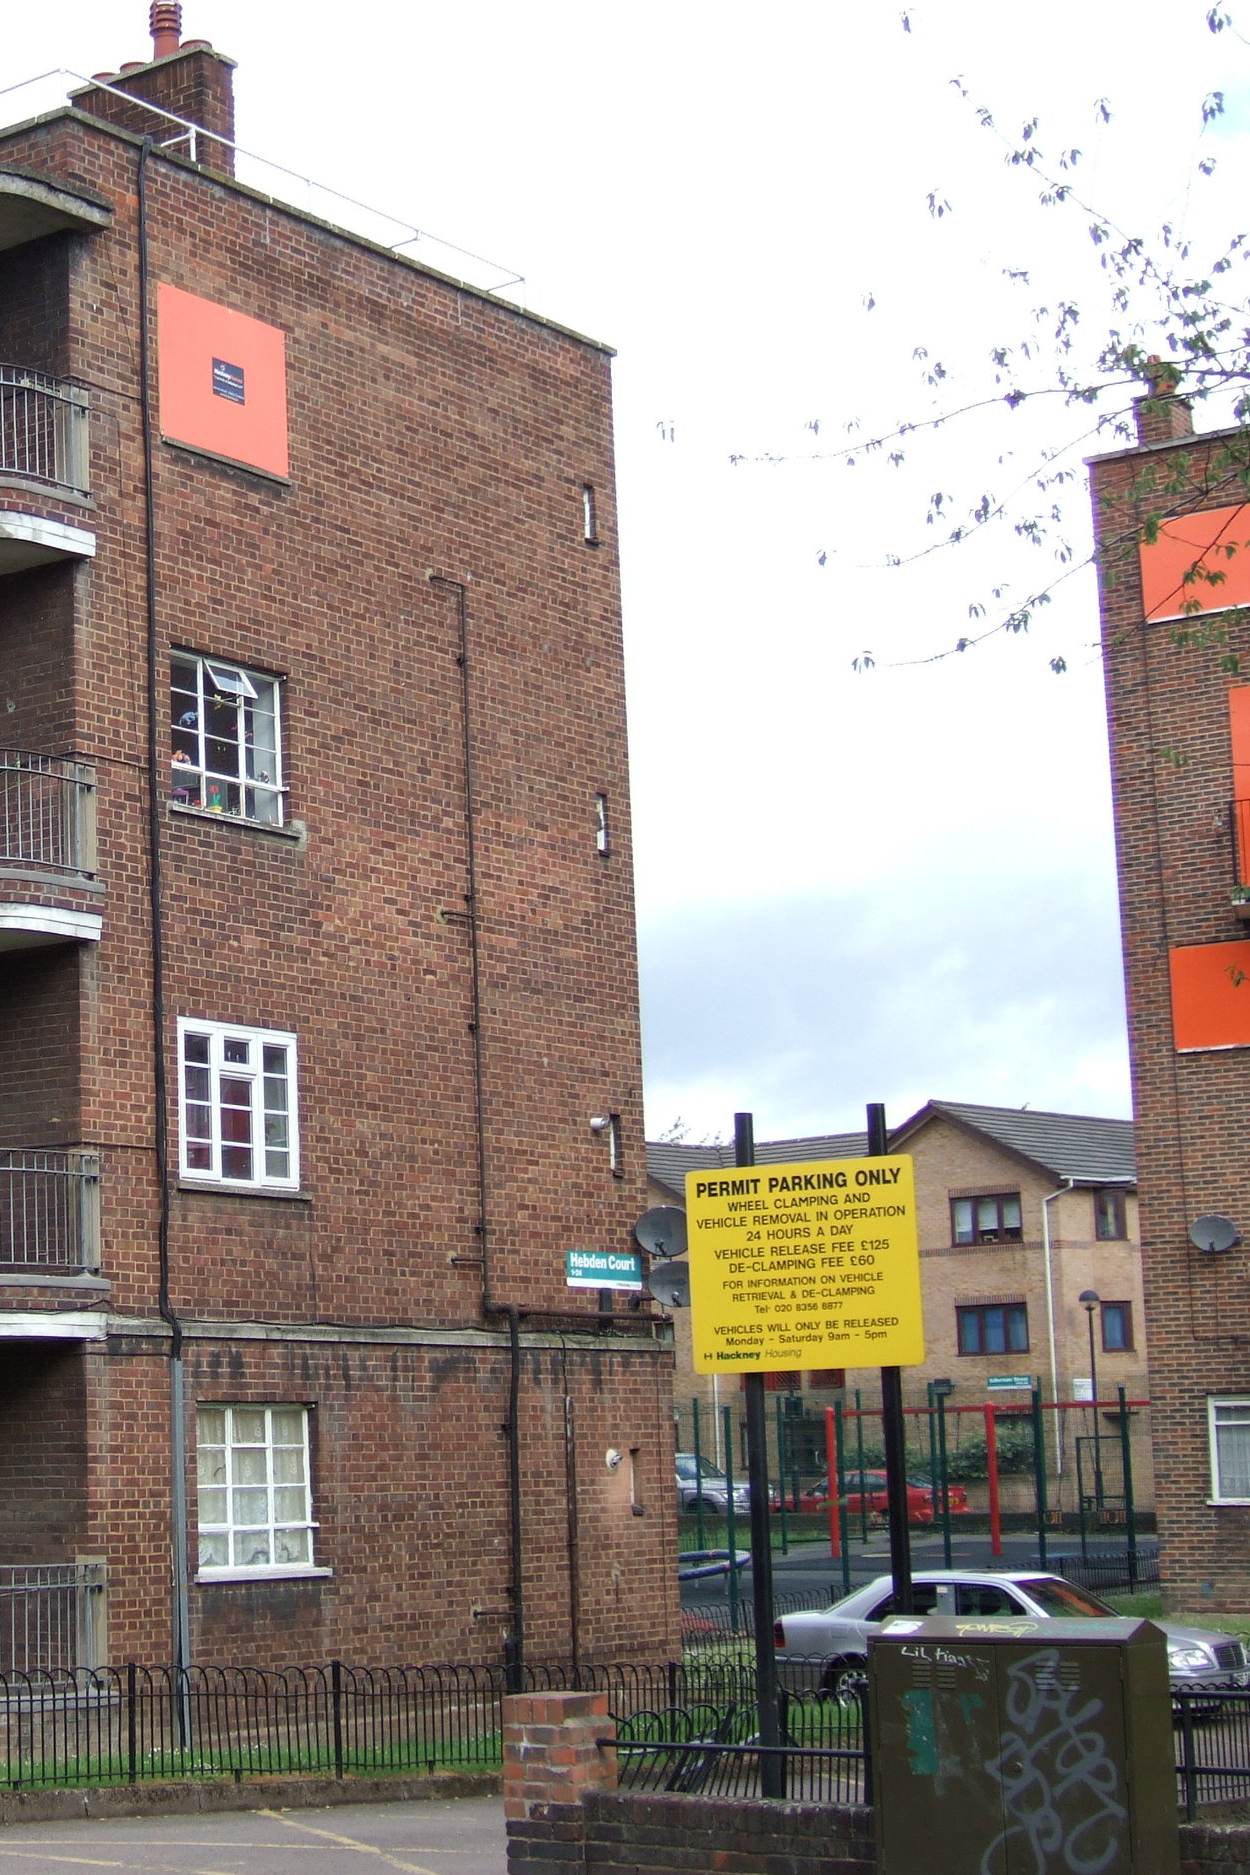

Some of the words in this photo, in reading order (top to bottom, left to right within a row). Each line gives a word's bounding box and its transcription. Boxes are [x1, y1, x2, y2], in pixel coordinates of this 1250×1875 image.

[696, 1178, 761, 1198] PERMIT
[768, 1172, 847, 1193] PARKING
[855, 1167, 901, 1187] ONLY
[727, 1200, 769, 1212] WHEEL
[774, 1194, 838, 1209] CLAMPING
[844, 1192, 871, 1204] AND
[696, 1216, 747, 1229] VEHICLE
[753, 1212, 812, 1226] REMOVAL
[816, 1211, 828, 1221] IN
[833, 1205, 906, 1220] OPERATION
[746, 1231, 761, 1241] 24
[767, 1227, 811, 1240] HOURS
[816, 1226, 825, 1236] A
[830, 1224, 854, 1236] DAY
[714, 1247, 765, 1260] VEHICLE
[770, 1243, 826, 1256] RELEASE
[831, 1241, 854, 1253] FEE
[861, 1239, 890, 1251] £125
[570, 1252, 607, 1269] Hebden
[608, 1255, 636, 1271] Court
[729, 1258, 816, 1273] DE-CLAMPING
[821, 1256, 844, 1268] FEE
[850, 1254, 875, 1266] £60
[722, 1280, 743, 1290] FOR
[747, 1276, 816, 1288] INFORMATION
[820, 1274, 836, 1284] ON
[839, 1272, 884, 1283] VEHICLE
[732, 1291, 786, 1302] RETRIEVAL
[790, 1290, 797, 1299] &
[802, 1286, 875, 1298] DE-CLAMPING
[774, 1304, 792, 1313] 020
[796, 1302, 818, 1311] 8356
[821, 1301, 843, 1310] 8877
[714, 1324, 763, 1335] VEHICLES
[767, 1323, 791, 1332] WILL
[795, 1321, 821, 1331] ONLY
[825, 1320, 839, 1329] BE
[843, 1317, 899, 1328] RELEASED
[725, 1336, 765, 1346] Monday
[778, 1332, 824, 1344] Saturday
[828, 1331, 850, 1341] 9am
[864, 1330, 887, 1341] 5pm
[716, 1350, 761, 1360] Hackney
[764, 1348, 803, 1359] Housing
